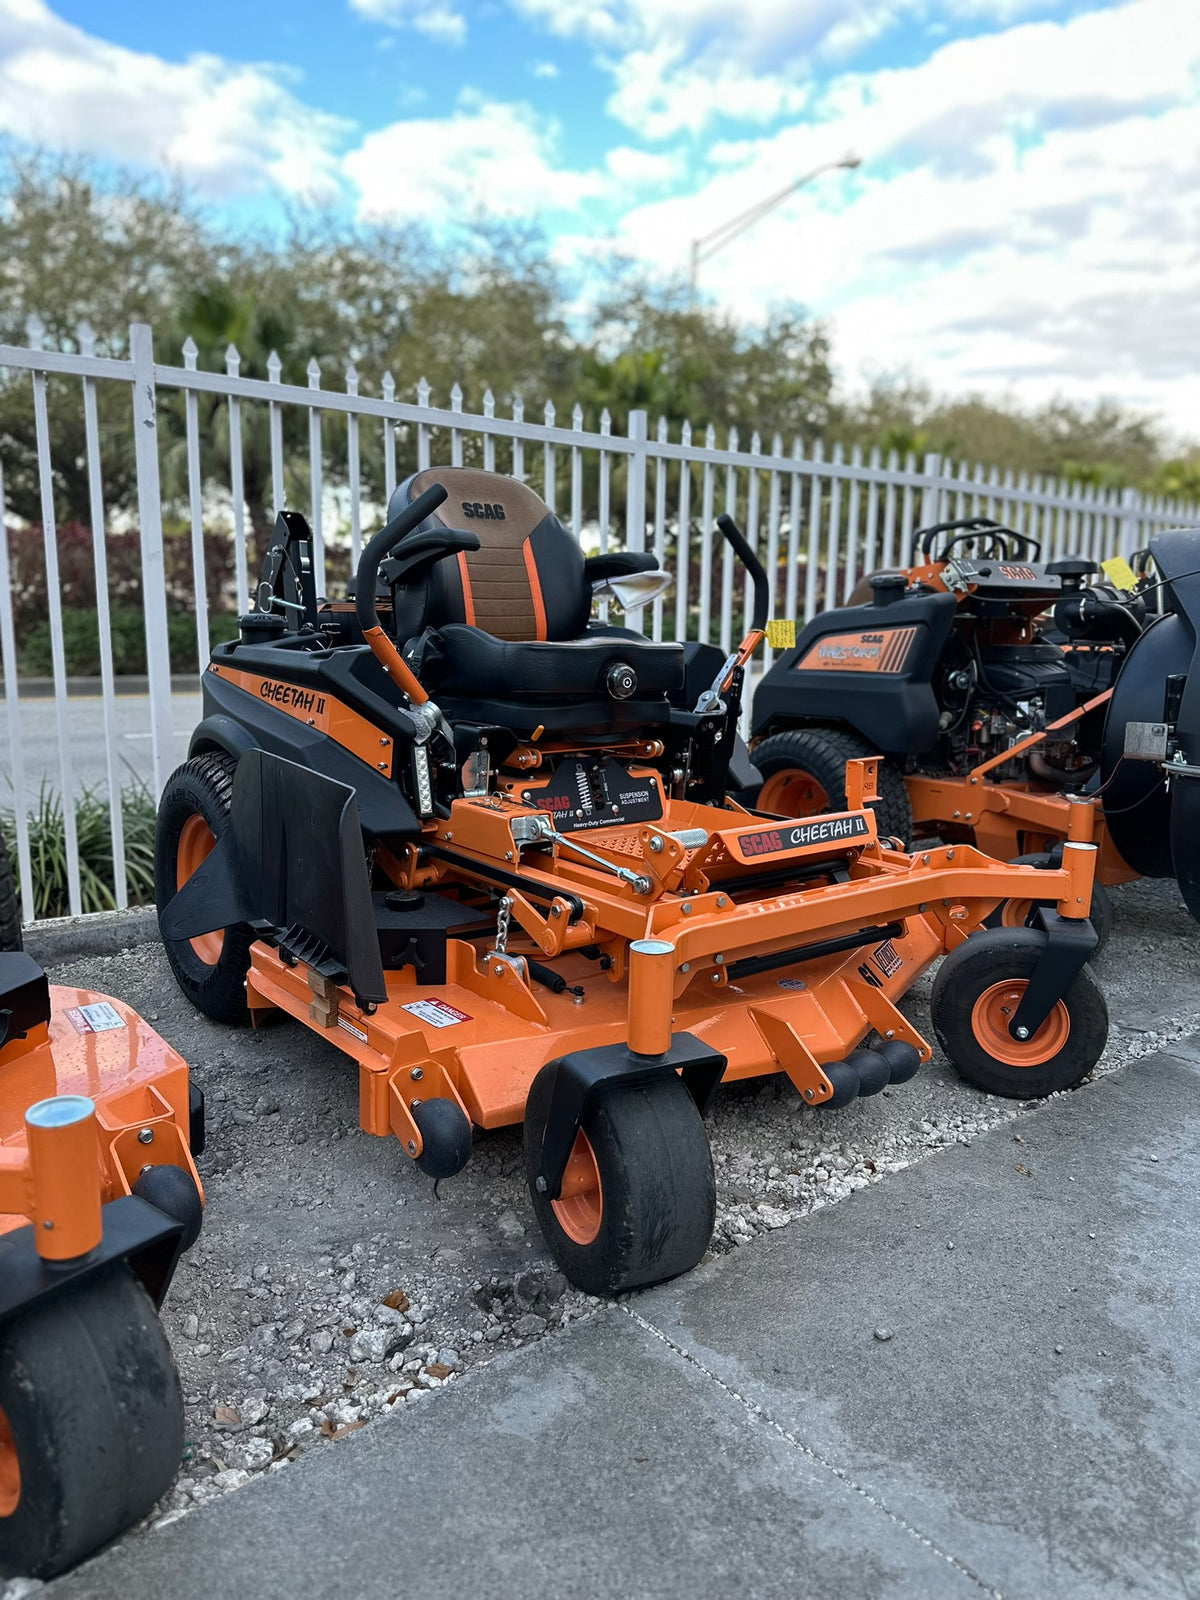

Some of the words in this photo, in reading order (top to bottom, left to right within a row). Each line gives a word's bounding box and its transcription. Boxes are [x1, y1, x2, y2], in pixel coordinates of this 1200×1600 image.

[461, 502, 506, 521] SCAG
[860, 635, 884, 644] SCAG
[260, 681, 316, 713] CHEETAH
[316, 697, 326, 715] II
[537, 795, 571, 811] SCAG
[619, 790, 650, 801] SUSPENSION
[621, 796, 650, 805] ADJUSTMENT
[573, 820, 599, 829] Heavy-Duty
[600, 816, 625, 826] Commercial
[740, 831, 783, 856] SCAG
[790, 819, 853, 845] CHEETAH
[856, 818, 865, 832] II
[857, 961, 884, 989] 61
[437, 1003, 467, 1020] DANGER
